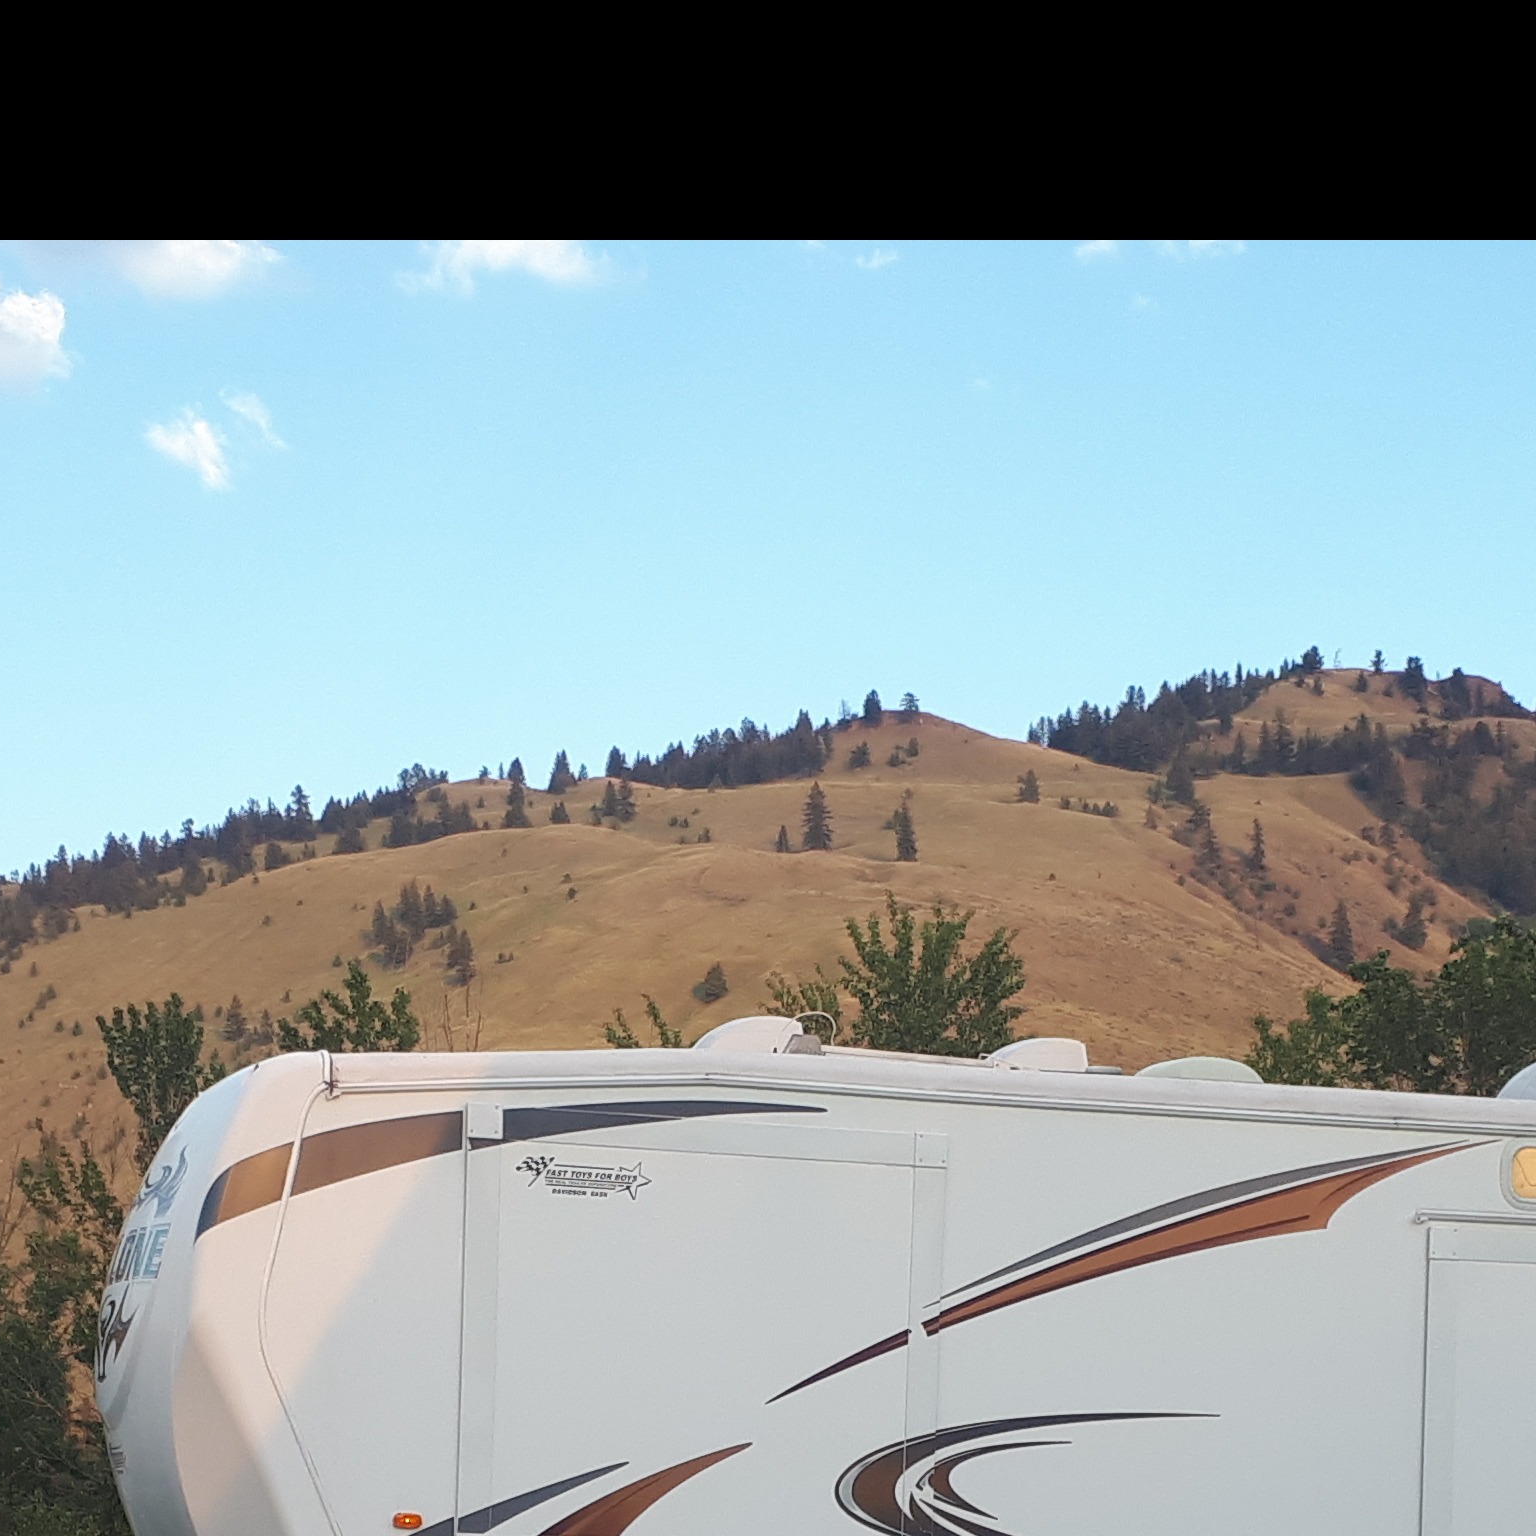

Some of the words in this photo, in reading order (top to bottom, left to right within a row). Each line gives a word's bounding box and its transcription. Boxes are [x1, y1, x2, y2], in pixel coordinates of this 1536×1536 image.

[546, 1169, 569, 1178] FAST
[571, 1170, 593, 1179] TOYS
[595, 1172, 613, 1181] FOR
[614, 1174, 638, 1183] BOYS
